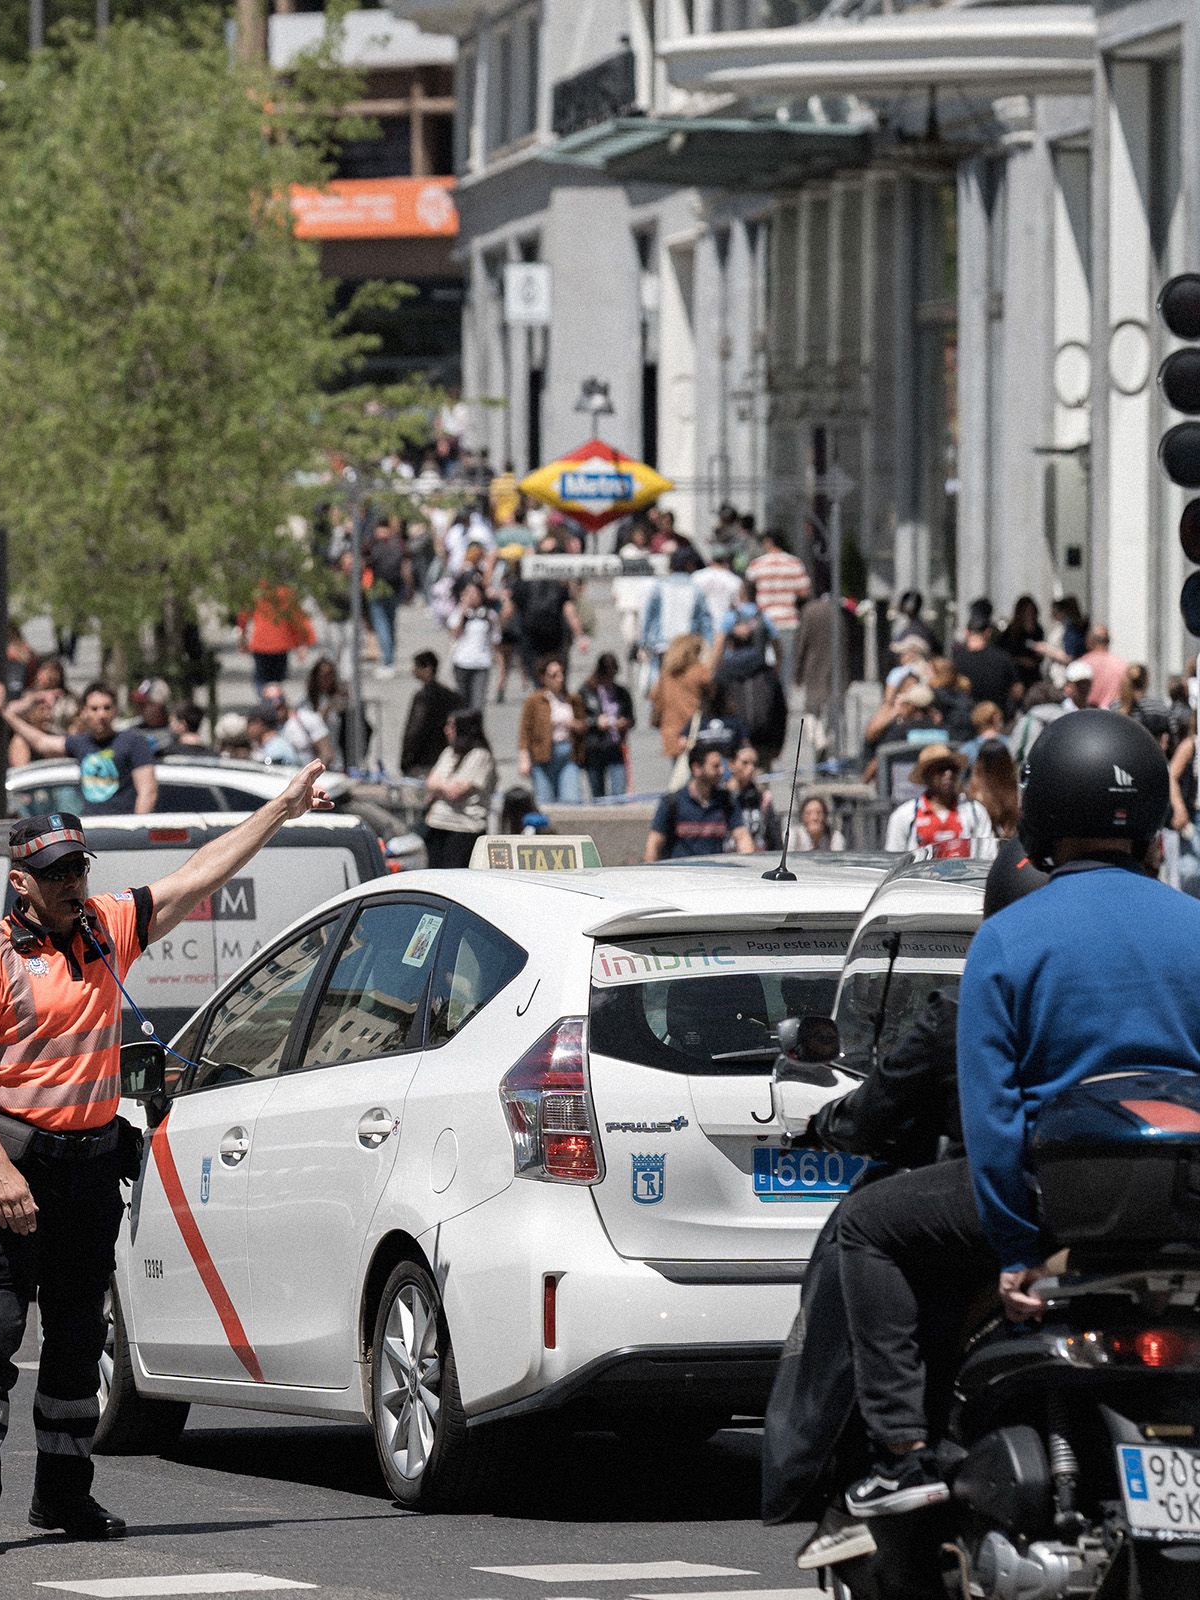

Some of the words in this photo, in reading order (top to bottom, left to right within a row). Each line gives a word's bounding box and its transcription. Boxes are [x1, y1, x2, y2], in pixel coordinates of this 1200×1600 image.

[566, 474, 629, 497] Metro
[520, 849, 576, 871] TAXI
[140, 939, 198, 961] ARC
[221, 939, 263, 959] MA
[747, 941, 780, 952] Paga
[783, 939, 811, 949] este
[815, 936, 838, 949] taxi
[929, 943, 950, 953] con
[600, 942, 736, 977] imbric
